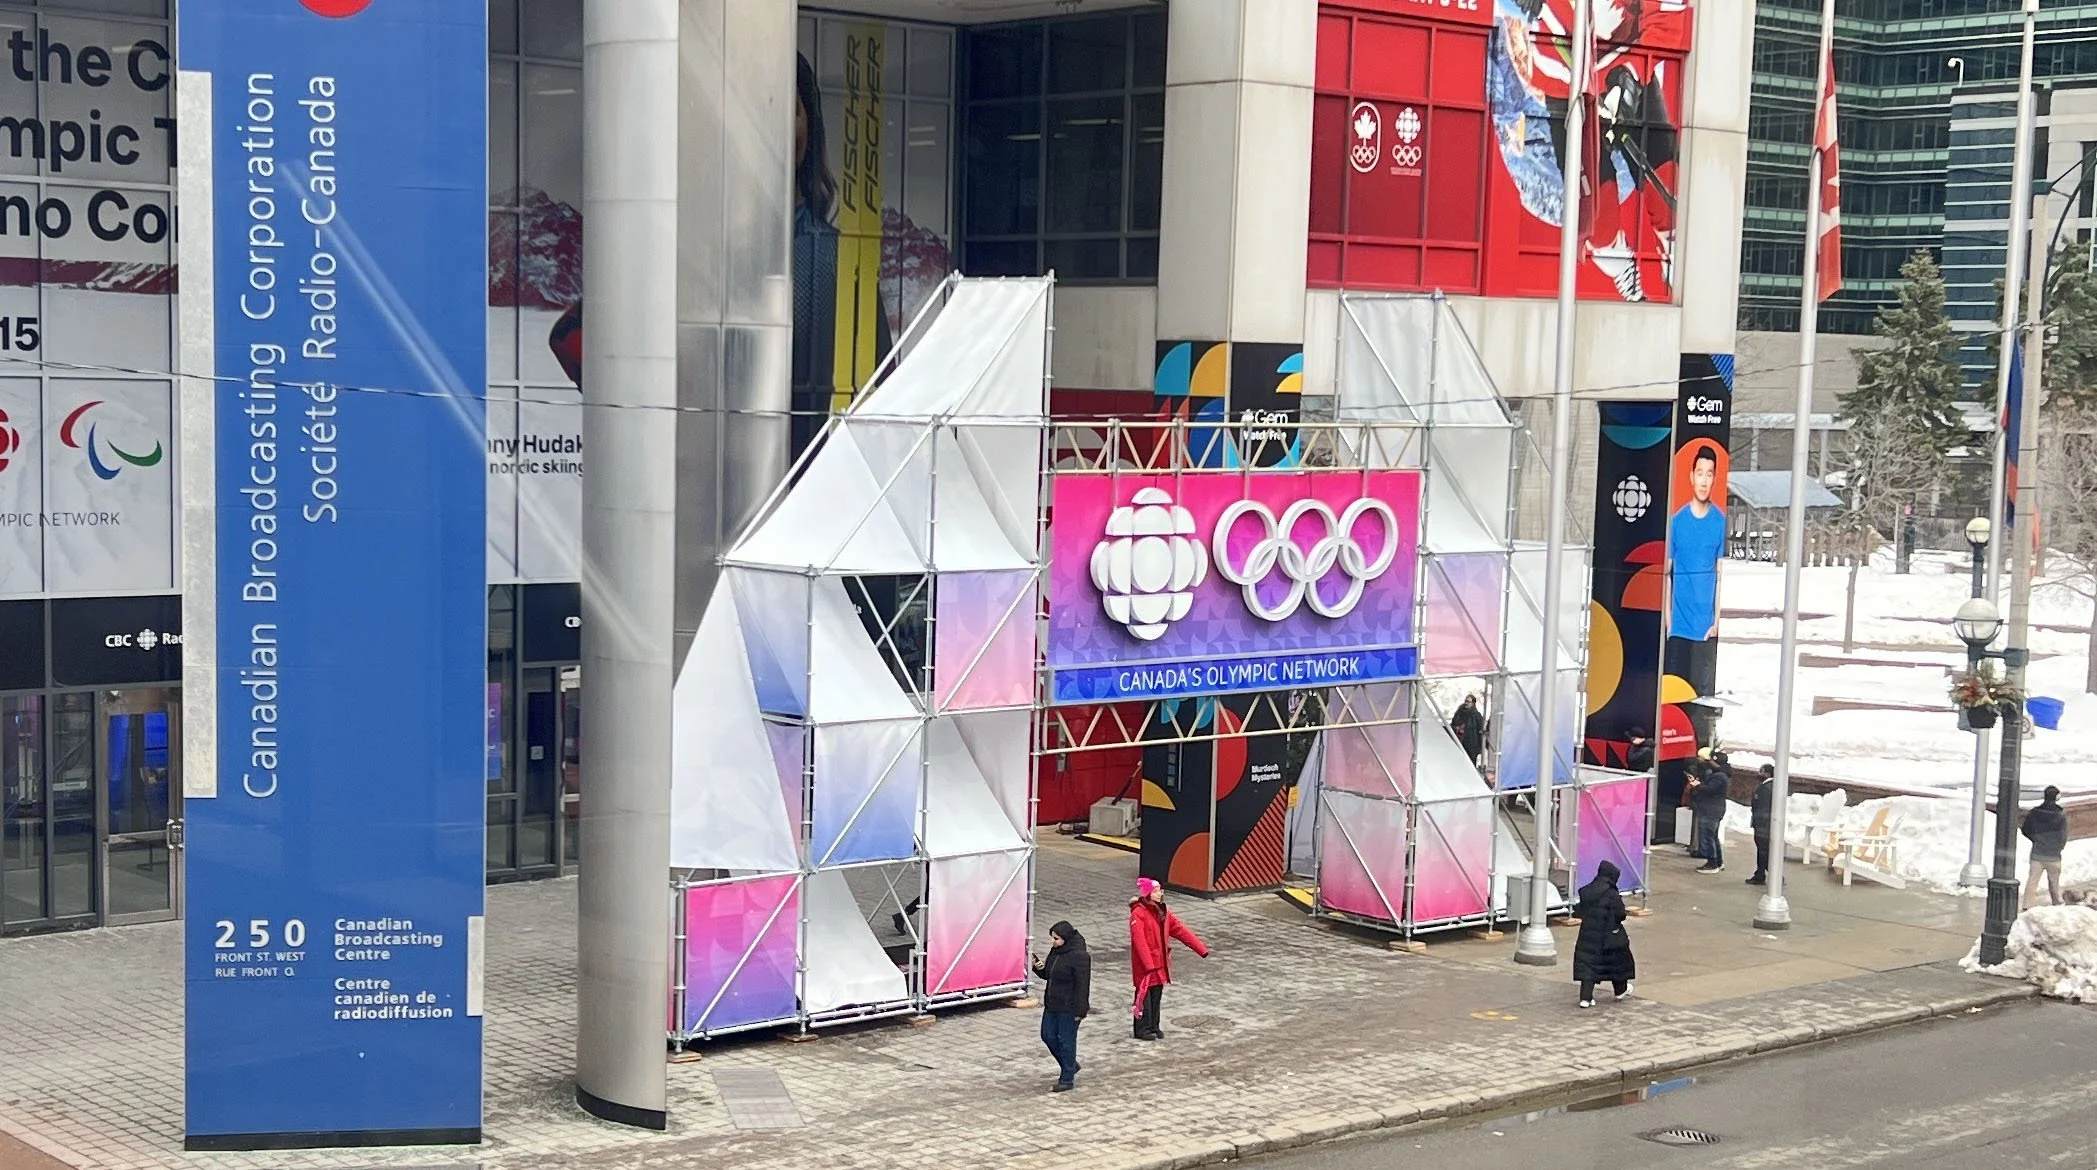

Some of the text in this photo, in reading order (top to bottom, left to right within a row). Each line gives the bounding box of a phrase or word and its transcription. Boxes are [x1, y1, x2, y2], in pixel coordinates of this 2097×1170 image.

[8, 28, 178, 92] the C
[842, 34, 860, 213] FISCHER
[864, 36, 881, 215] FISCHER
[87, 190, 178, 244] Co
[298, 76, 337, 524] Société Radio-Canada
[1696, 396, 1723, 412] Gem
[236, 73, 286, 798] Canadian Broadcasting Corporation
[39, 511, 120, 526] NETWORK
[105, 633, 132, 648] CBC
[1119, 657, 1361, 692] CANADA'S OLYMPIC NETWORK
[334, 917, 413, 931] Canadian
[334, 932, 443, 948] Broadcasting
[215, 952, 252, 962] FRONT
[275, 951, 306, 961] WEST
[334, 948, 391, 961] Centre
[215, 967, 237, 977] RUE
[241, 966, 278, 977] FRONT
[334, 978, 391, 990] Centre
[334, 990, 437, 1005] canadien de
[334, 1005, 453, 1020] radiodiffusion
